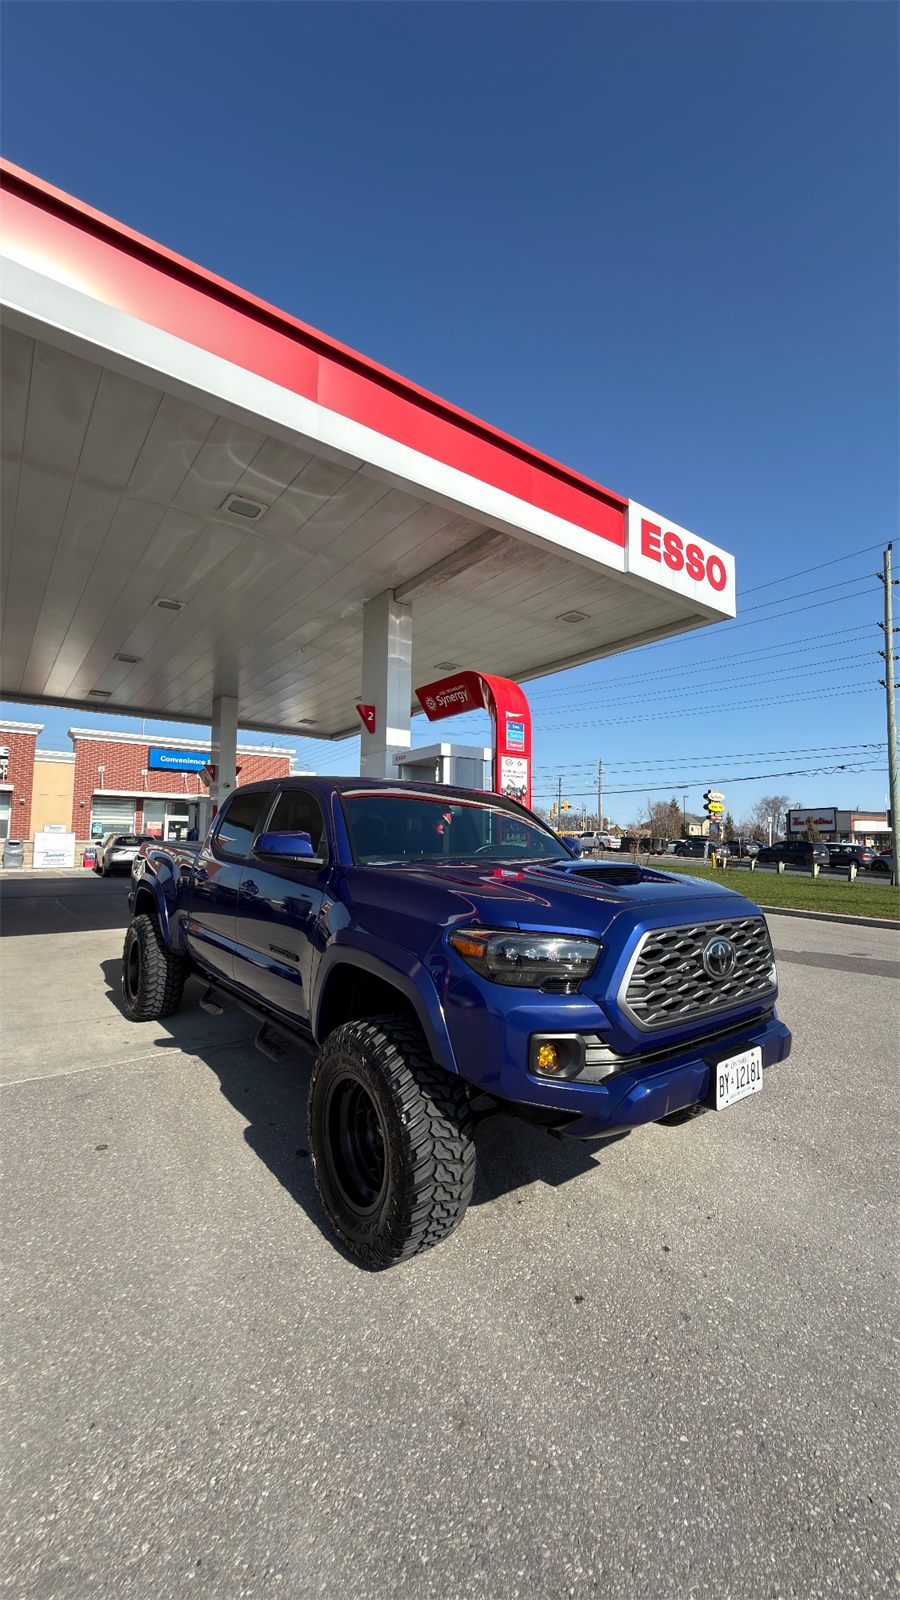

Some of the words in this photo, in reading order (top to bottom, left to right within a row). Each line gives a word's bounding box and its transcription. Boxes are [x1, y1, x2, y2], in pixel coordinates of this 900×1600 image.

[641, 518, 727, 591] ESSO
[436, 690, 468, 707] Synergy
[367, 711, 374, 721] 2
[160, 755, 206, 765] Convenience
[719, 1072, 730, 1097] BY
[736, 1060, 760, 1089] 12181
